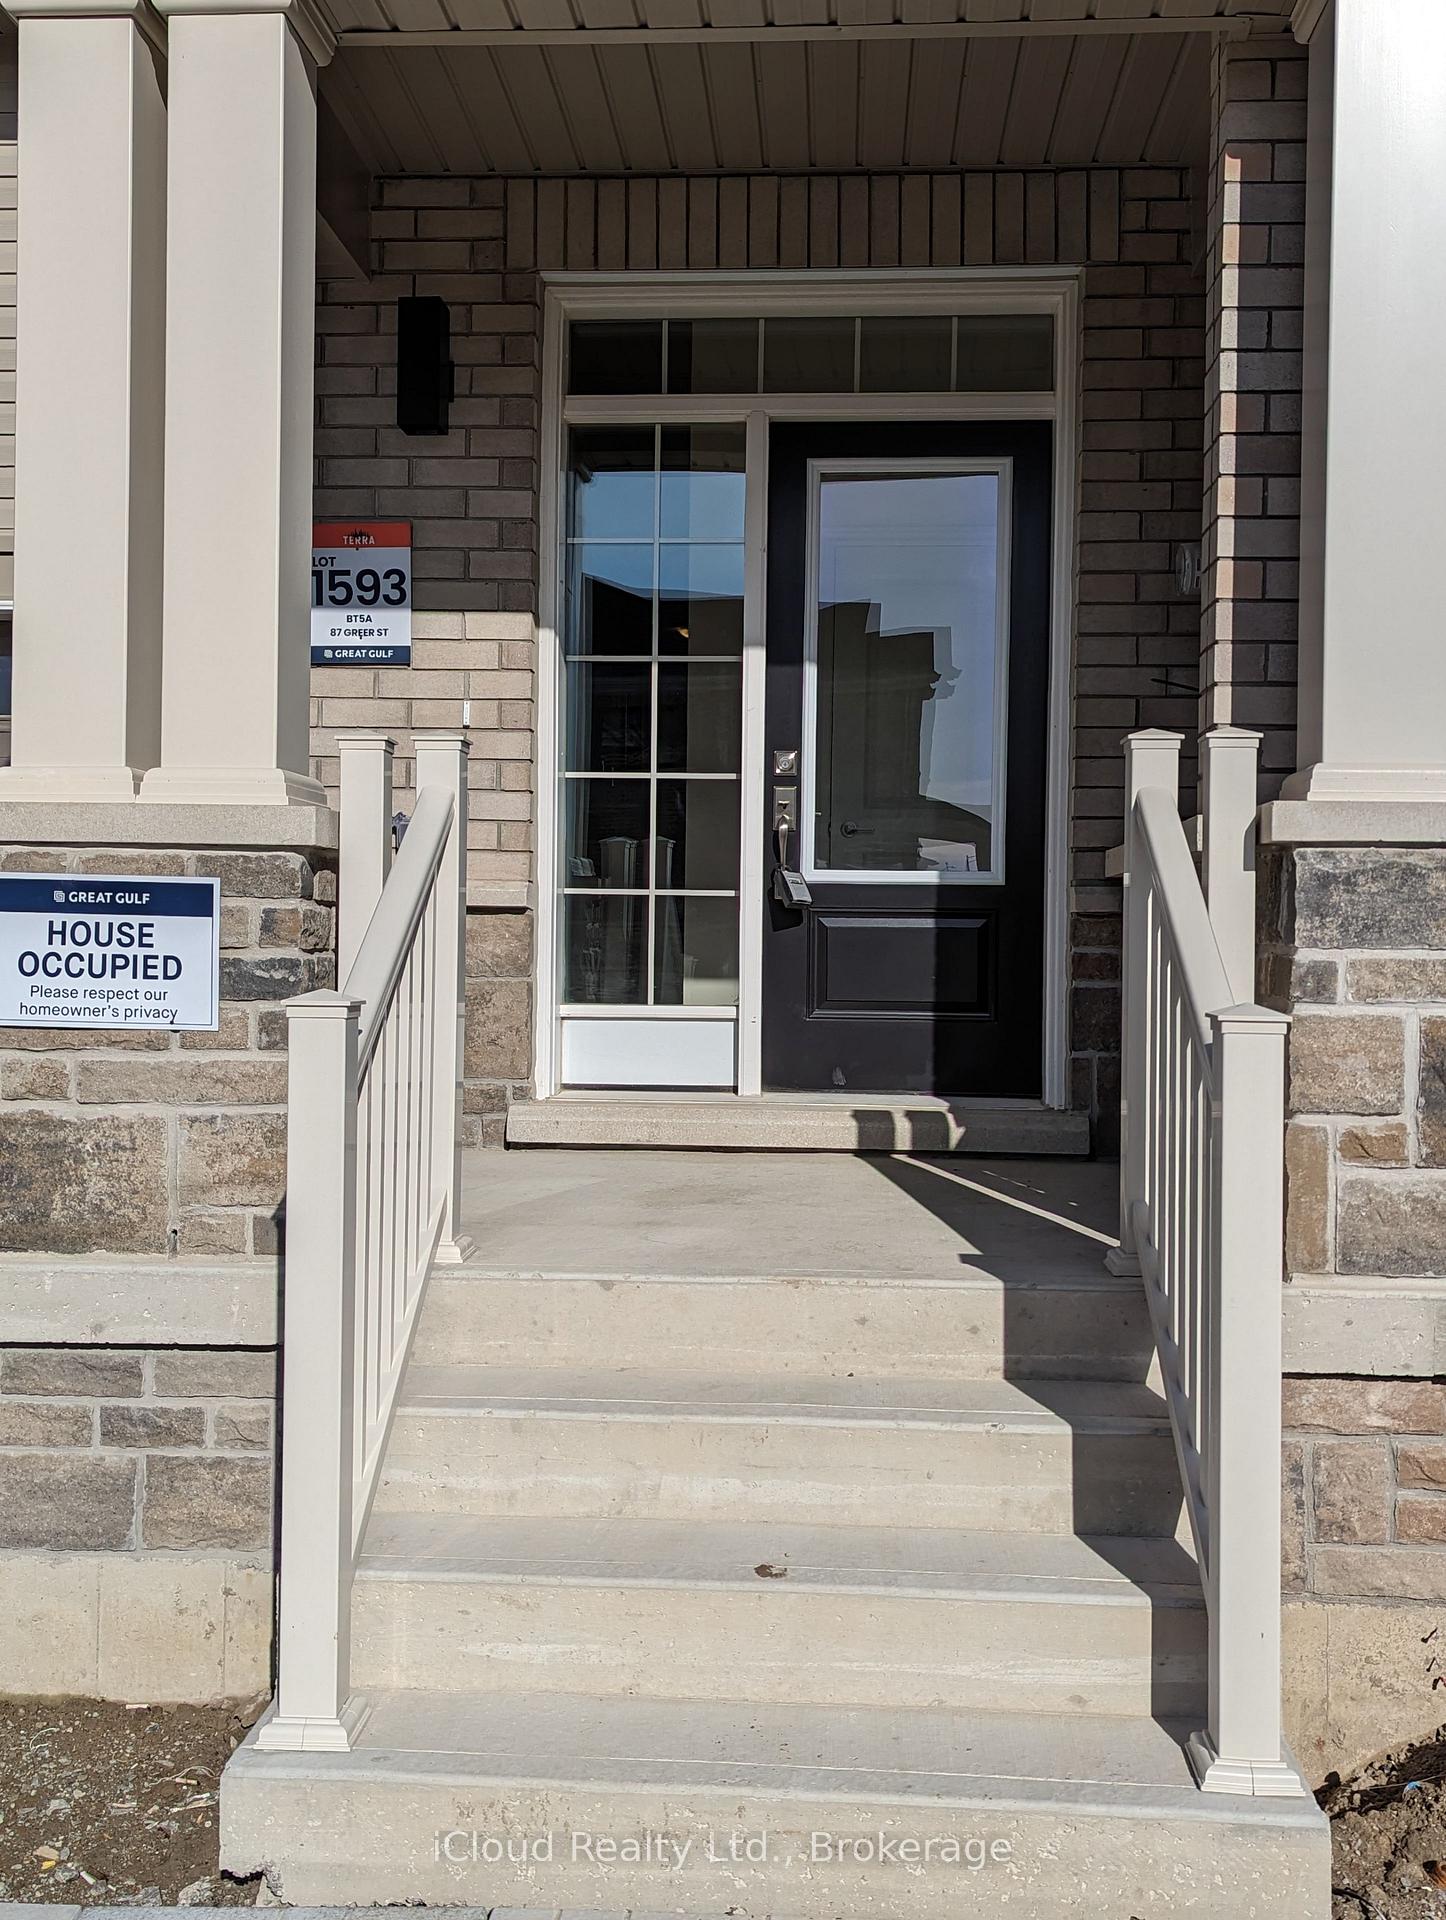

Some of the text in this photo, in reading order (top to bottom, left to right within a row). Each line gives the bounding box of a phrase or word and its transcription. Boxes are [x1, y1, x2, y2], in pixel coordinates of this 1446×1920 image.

[343, 535, 375, 545] TERRA
[312, 556, 336, 567] LOT
[312, 568, 407, 606] 1593
[346, 614, 372, 623] BT5A
[330, 628, 389, 637] 87 GREER ST
[335, 649, 394, 658] GREAT GULF
[68, 891, 150, 905] GREAT GULF
[47, 920, 155, 948] HOUSE
[17, 951, 183, 981] OCCUPIED
[30, 985, 169, 1003] Please respect our
[124, 1005, 178, 1022] privacy
